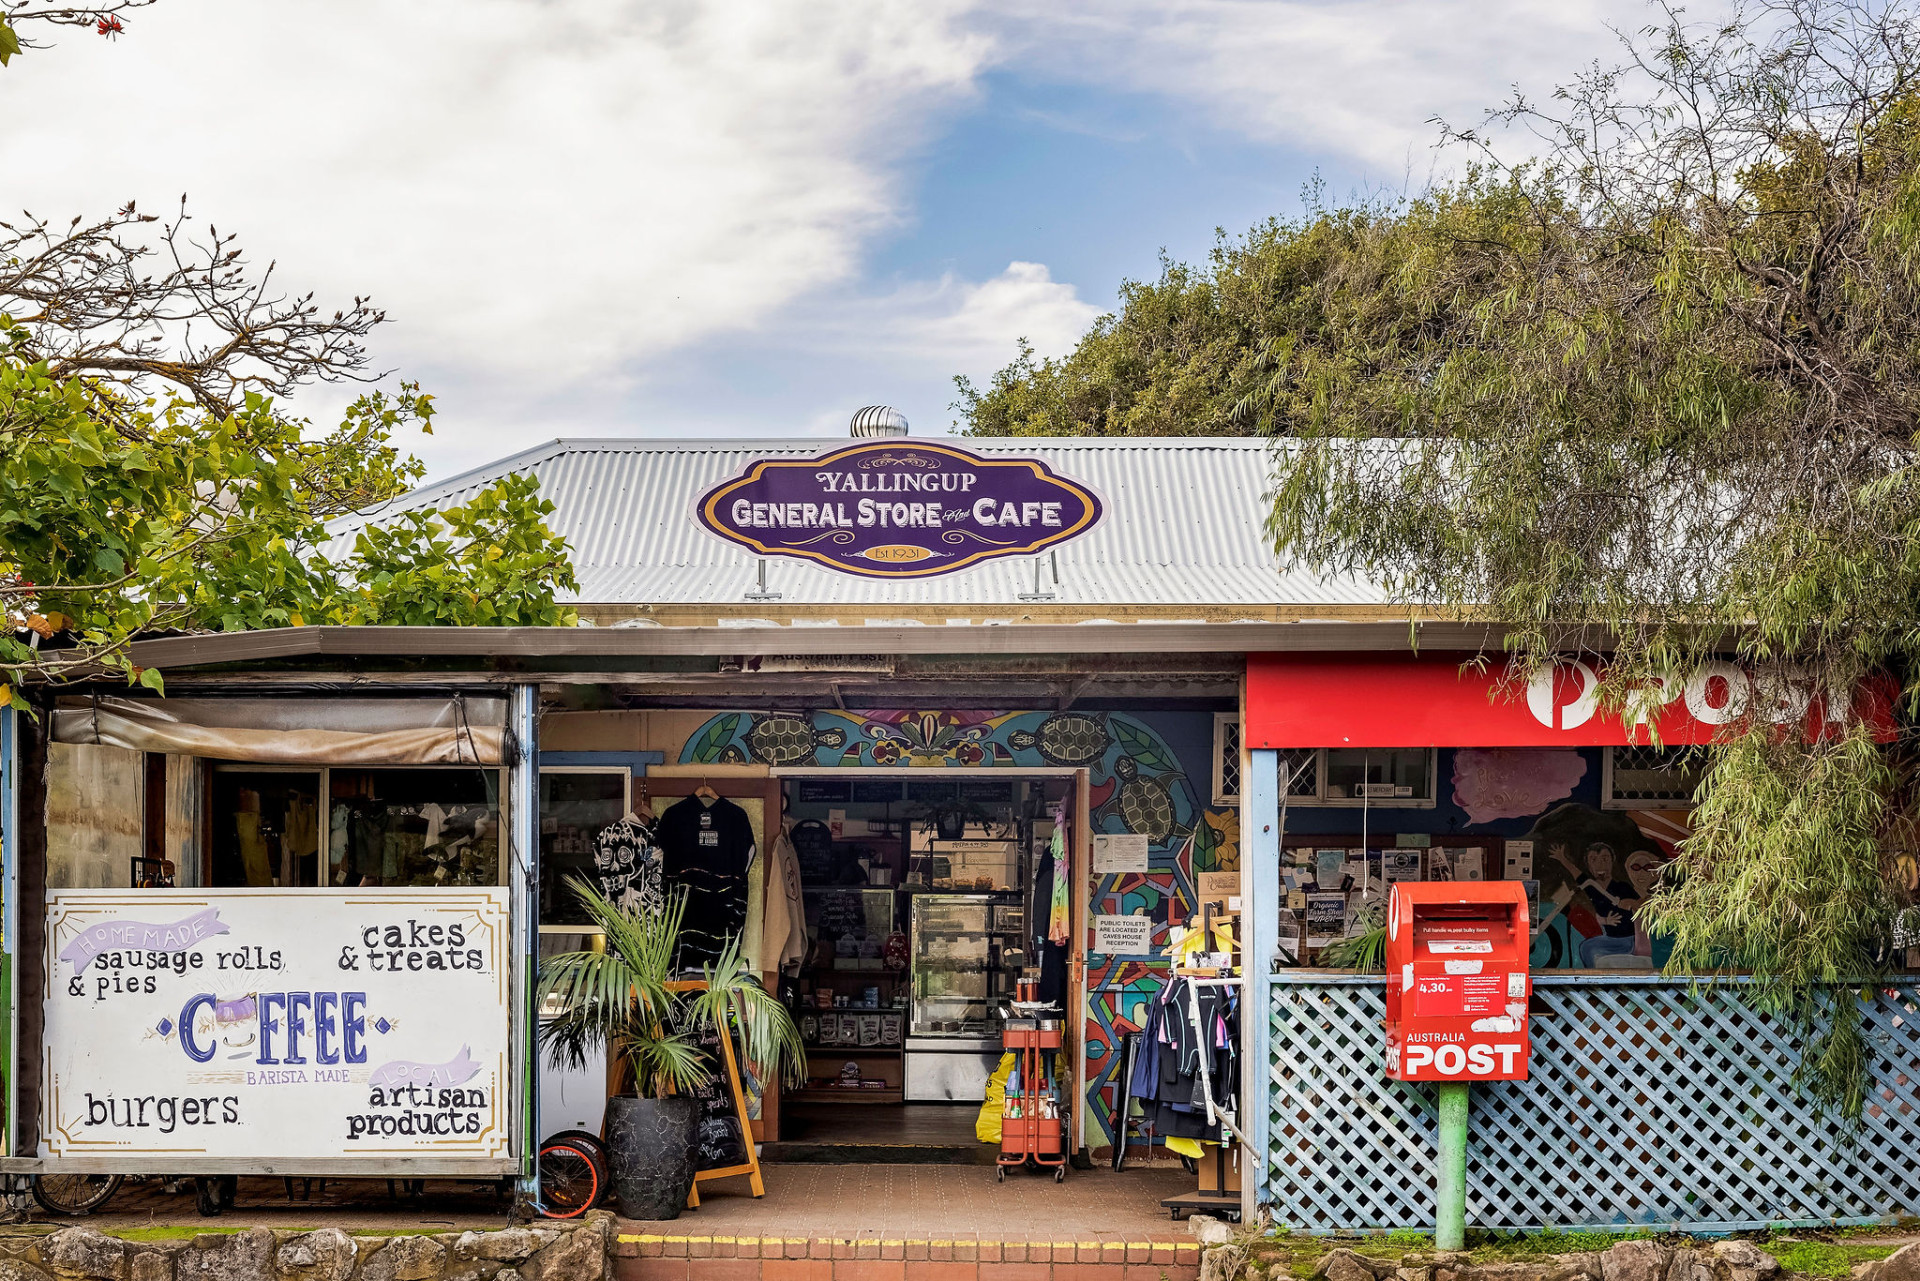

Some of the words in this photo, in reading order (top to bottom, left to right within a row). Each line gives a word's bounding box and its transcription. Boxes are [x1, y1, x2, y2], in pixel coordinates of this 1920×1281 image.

[815, 471, 977, 493] YALLINGUP
[731, 498, 853, 529] GENERAL
[857, 498, 943, 529] STORE
[942, 508, 972, 522] And
[972, 497, 1063, 529] CAFE
[874, 548, 890, 559] Est
[892, 548, 919, 559] 1931
[1313, 901, 1339, 911] Organic
[77, 926, 136, 956] HOME
[142, 917, 206, 948] MADE
[361, 920, 466, 949] cakes
[95, 950, 203, 974] sausage
[338, 946, 359, 971] &
[366, 946, 484, 972] treats
[68, 975, 86, 997] &
[96, 971, 157, 1000] pies
[1419, 982, 1447, 993] 4.30
[1406, 1033, 1465, 1043] AUSTRALIA
[1406, 1044, 1521, 1075] POST
[246, 1070, 308, 1086] BARISTA
[314, 1069, 350, 1083] MADE
[383, 1062, 456, 1085] LOCAL
[370, 1083, 488, 1109] artisan
[84, 1093, 239, 1134] burgers
[345, 1107, 482, 1140] products
